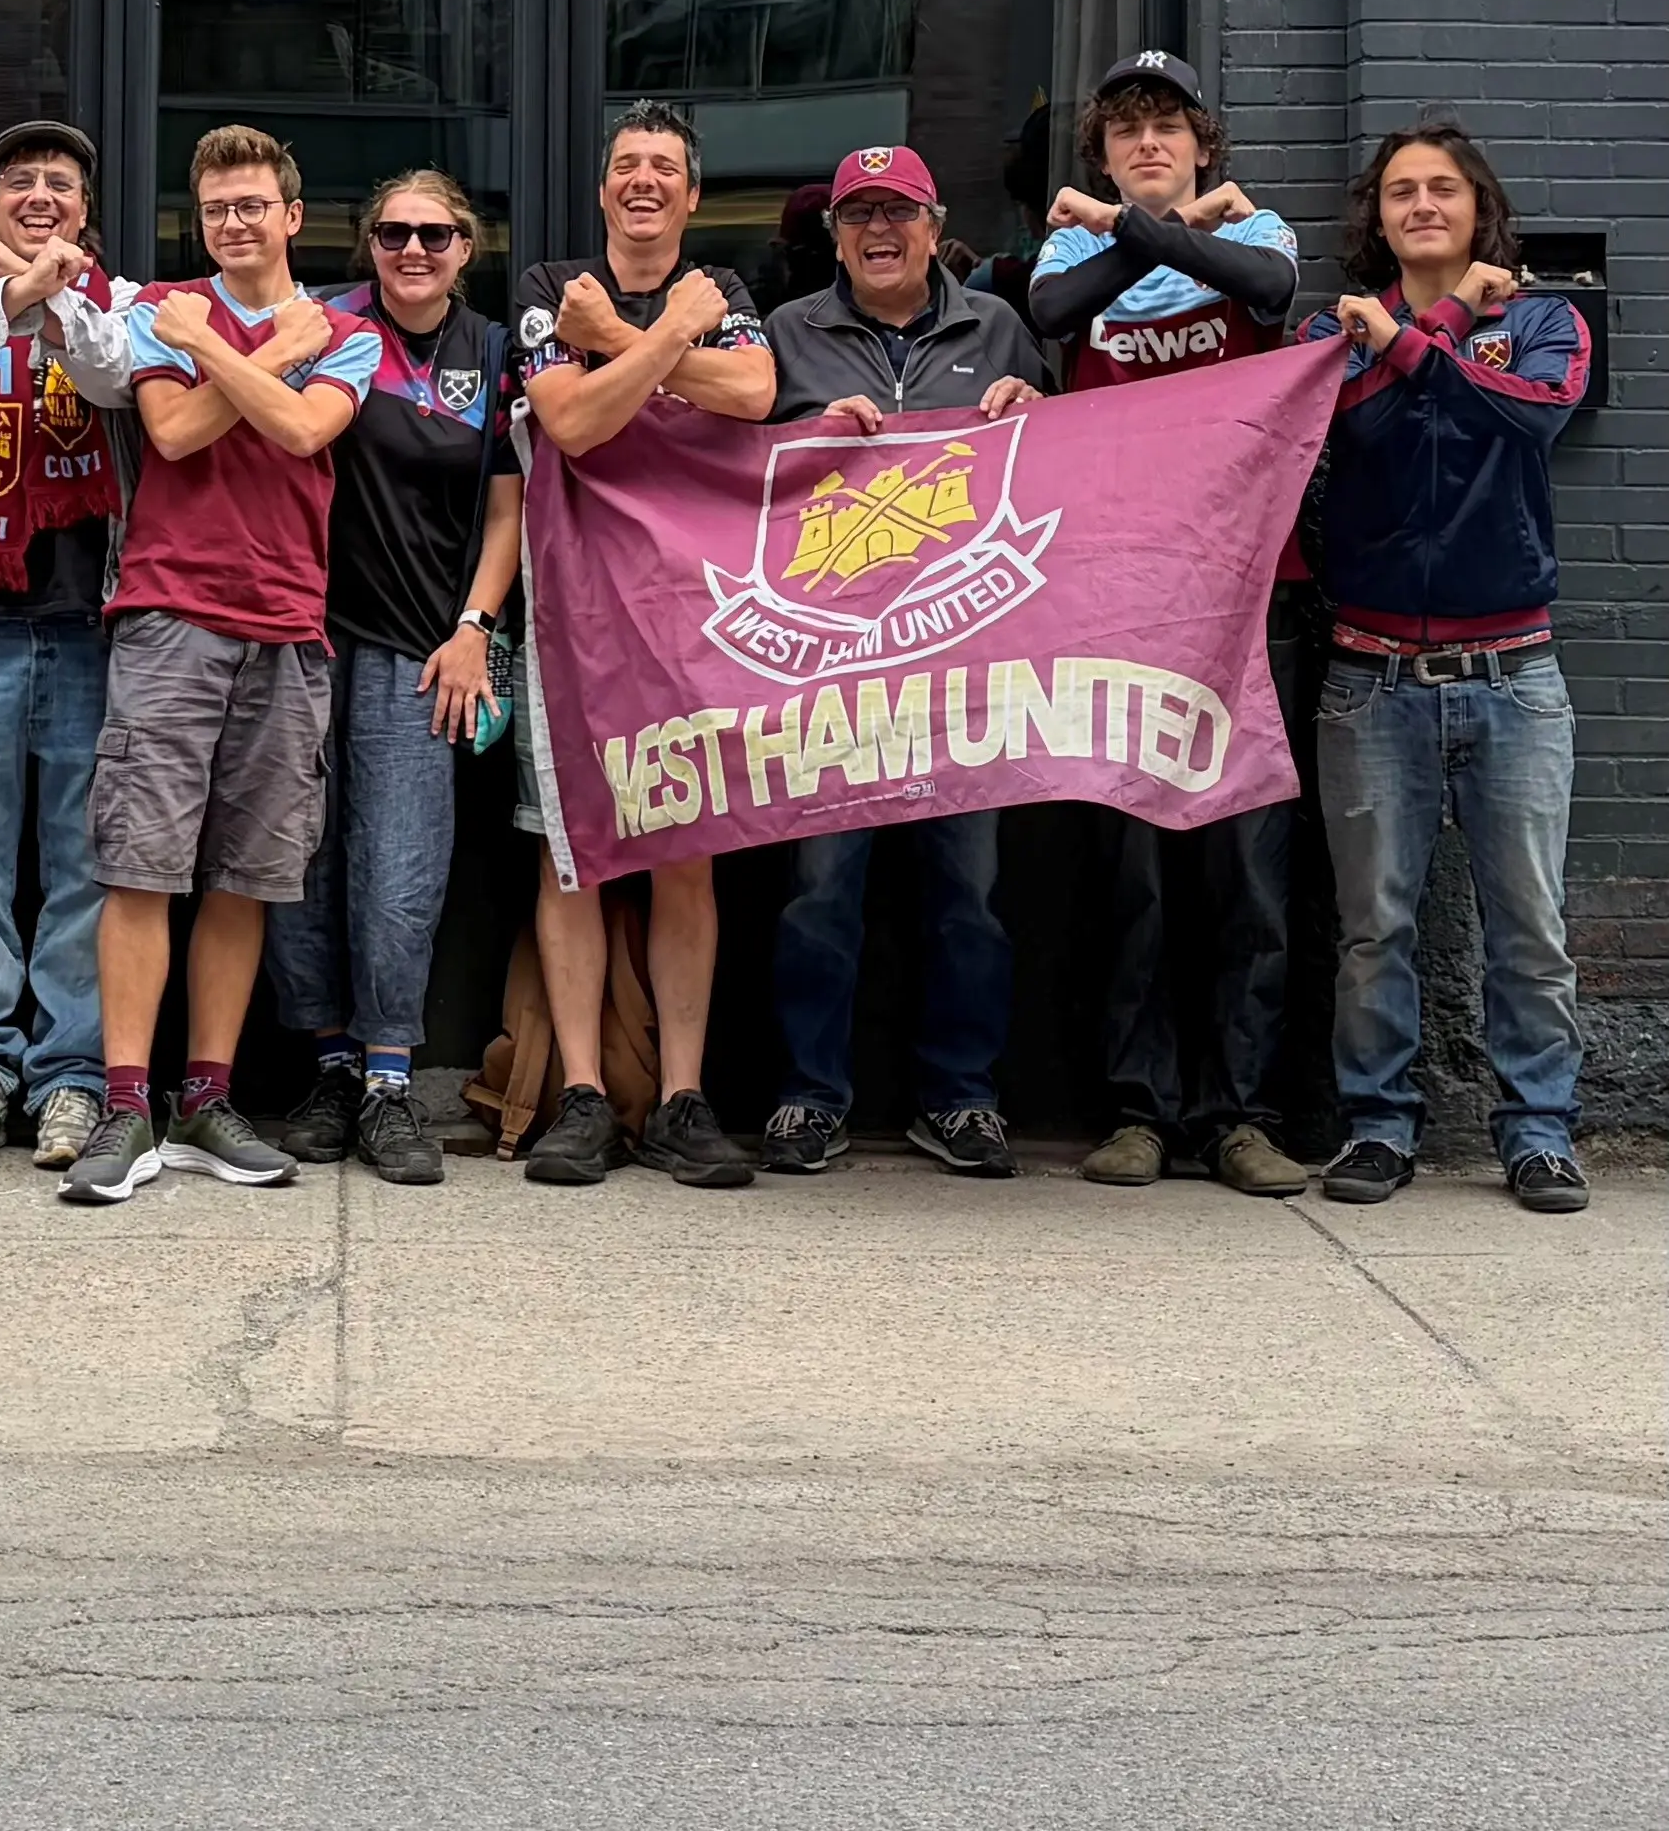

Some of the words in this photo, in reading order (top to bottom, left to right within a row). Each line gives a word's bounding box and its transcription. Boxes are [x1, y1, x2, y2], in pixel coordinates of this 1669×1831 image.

[44, 449, 102, 479] COYI
[726, 606, 820, 671] WEST
[890, 567, 1016, 648] UNITED
[593, 708, 740, 840] WEST
[743, 671, 933, 807] HAM
[945, 656, 1232, 793] UNITED
